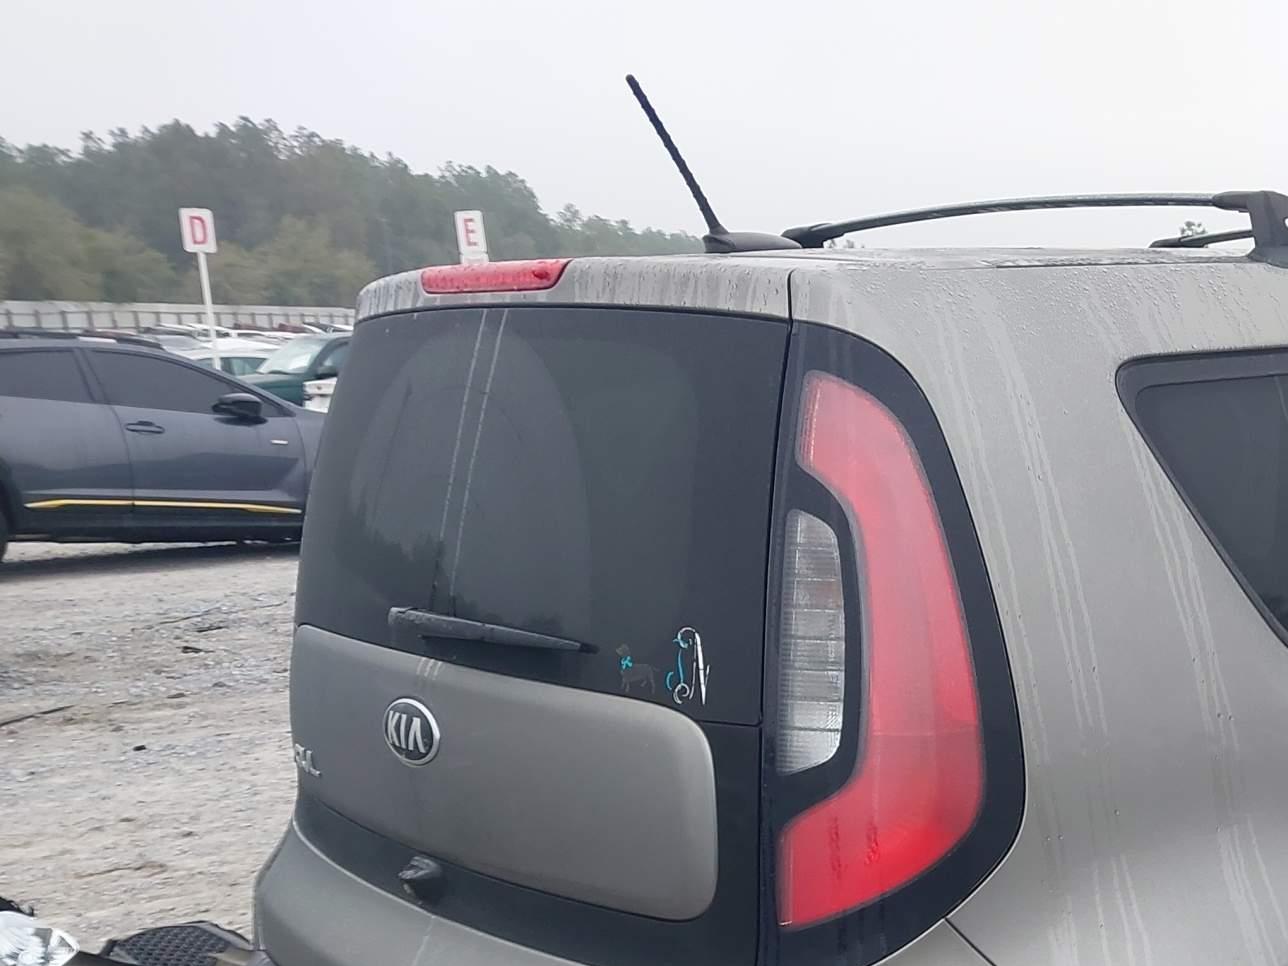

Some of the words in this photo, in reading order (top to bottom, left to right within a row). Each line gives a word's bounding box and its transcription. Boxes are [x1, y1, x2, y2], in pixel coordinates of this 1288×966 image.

[189, 215, 208, 245] D
[463, 218, 479, 247] E
[386, 709, 428, 755] KIA
